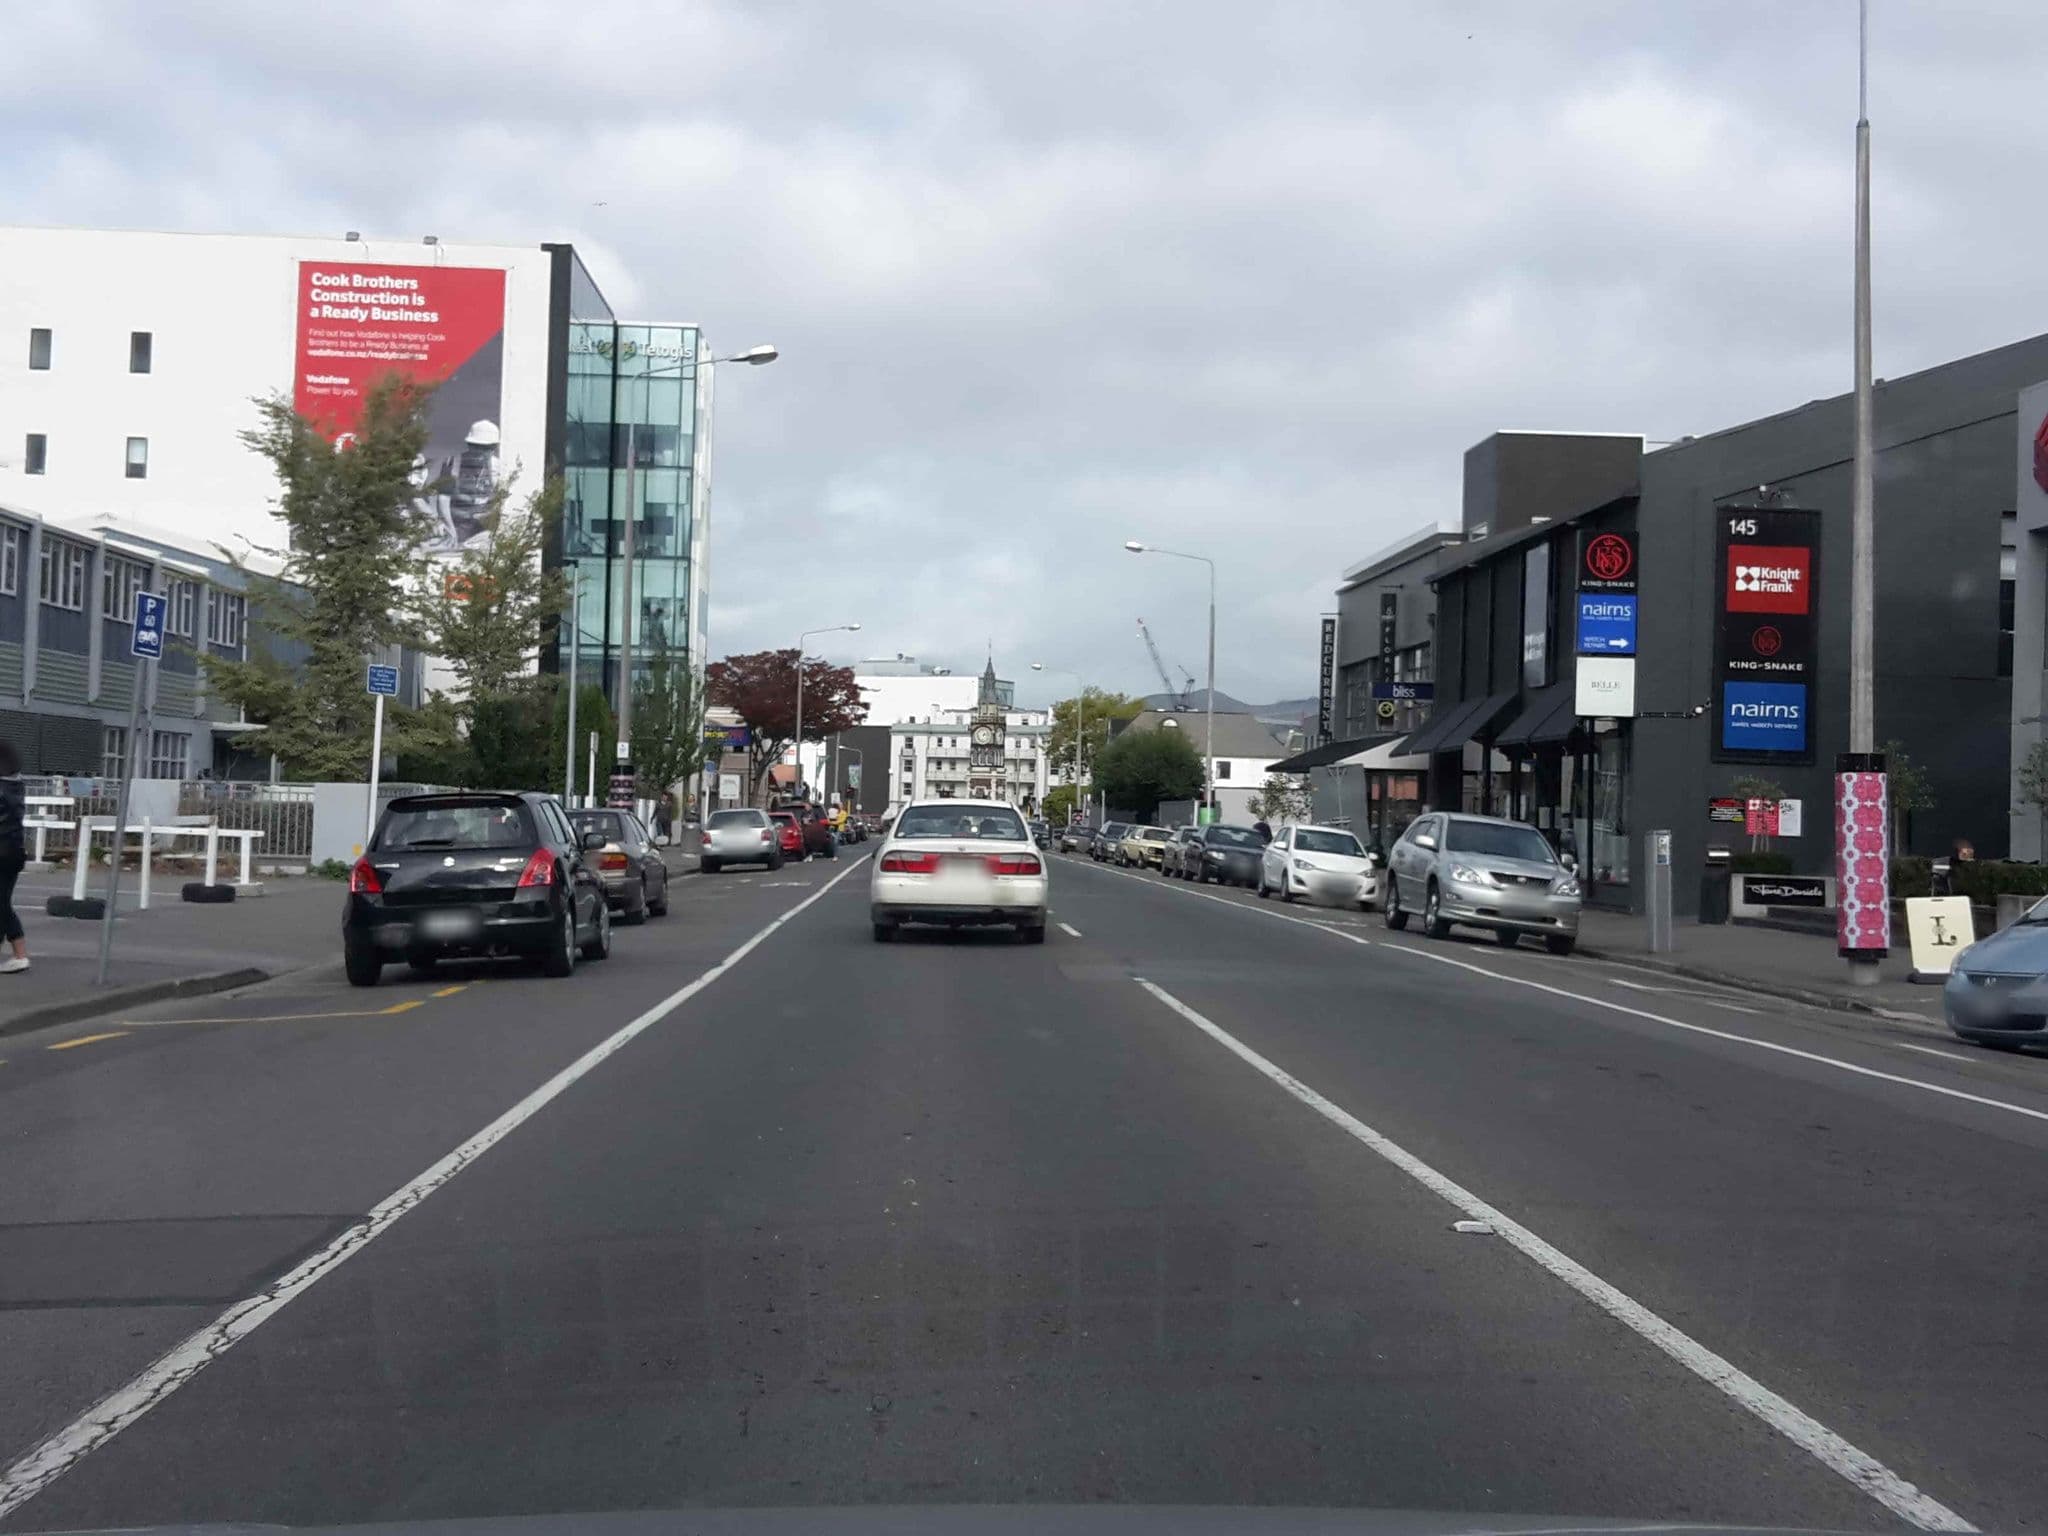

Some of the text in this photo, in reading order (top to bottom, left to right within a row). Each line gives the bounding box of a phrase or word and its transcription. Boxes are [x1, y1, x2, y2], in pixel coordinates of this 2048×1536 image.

[311, 272, 418, 290] Cook Brothers
[311, 289, 426, 306] Construction is
[310, 305, 439, 323] a Ready Business
[641, 343, 694, 361] Telogis
[306, 374, 350, 385] Vodafone
[1729, 519, 1757, 536] 145
[1761, 567, 1801, 582] Knight
[1760, 580, 1794, 593] Frank
[147, 598, 157, 613] P
[1582, 602, 1632, 616] nairns
[1729, 661, 1803, 671] KING-SNAKE
[1392, 684, 1416, 698] bliss
[1731, 701, 1799, 719] nairns
